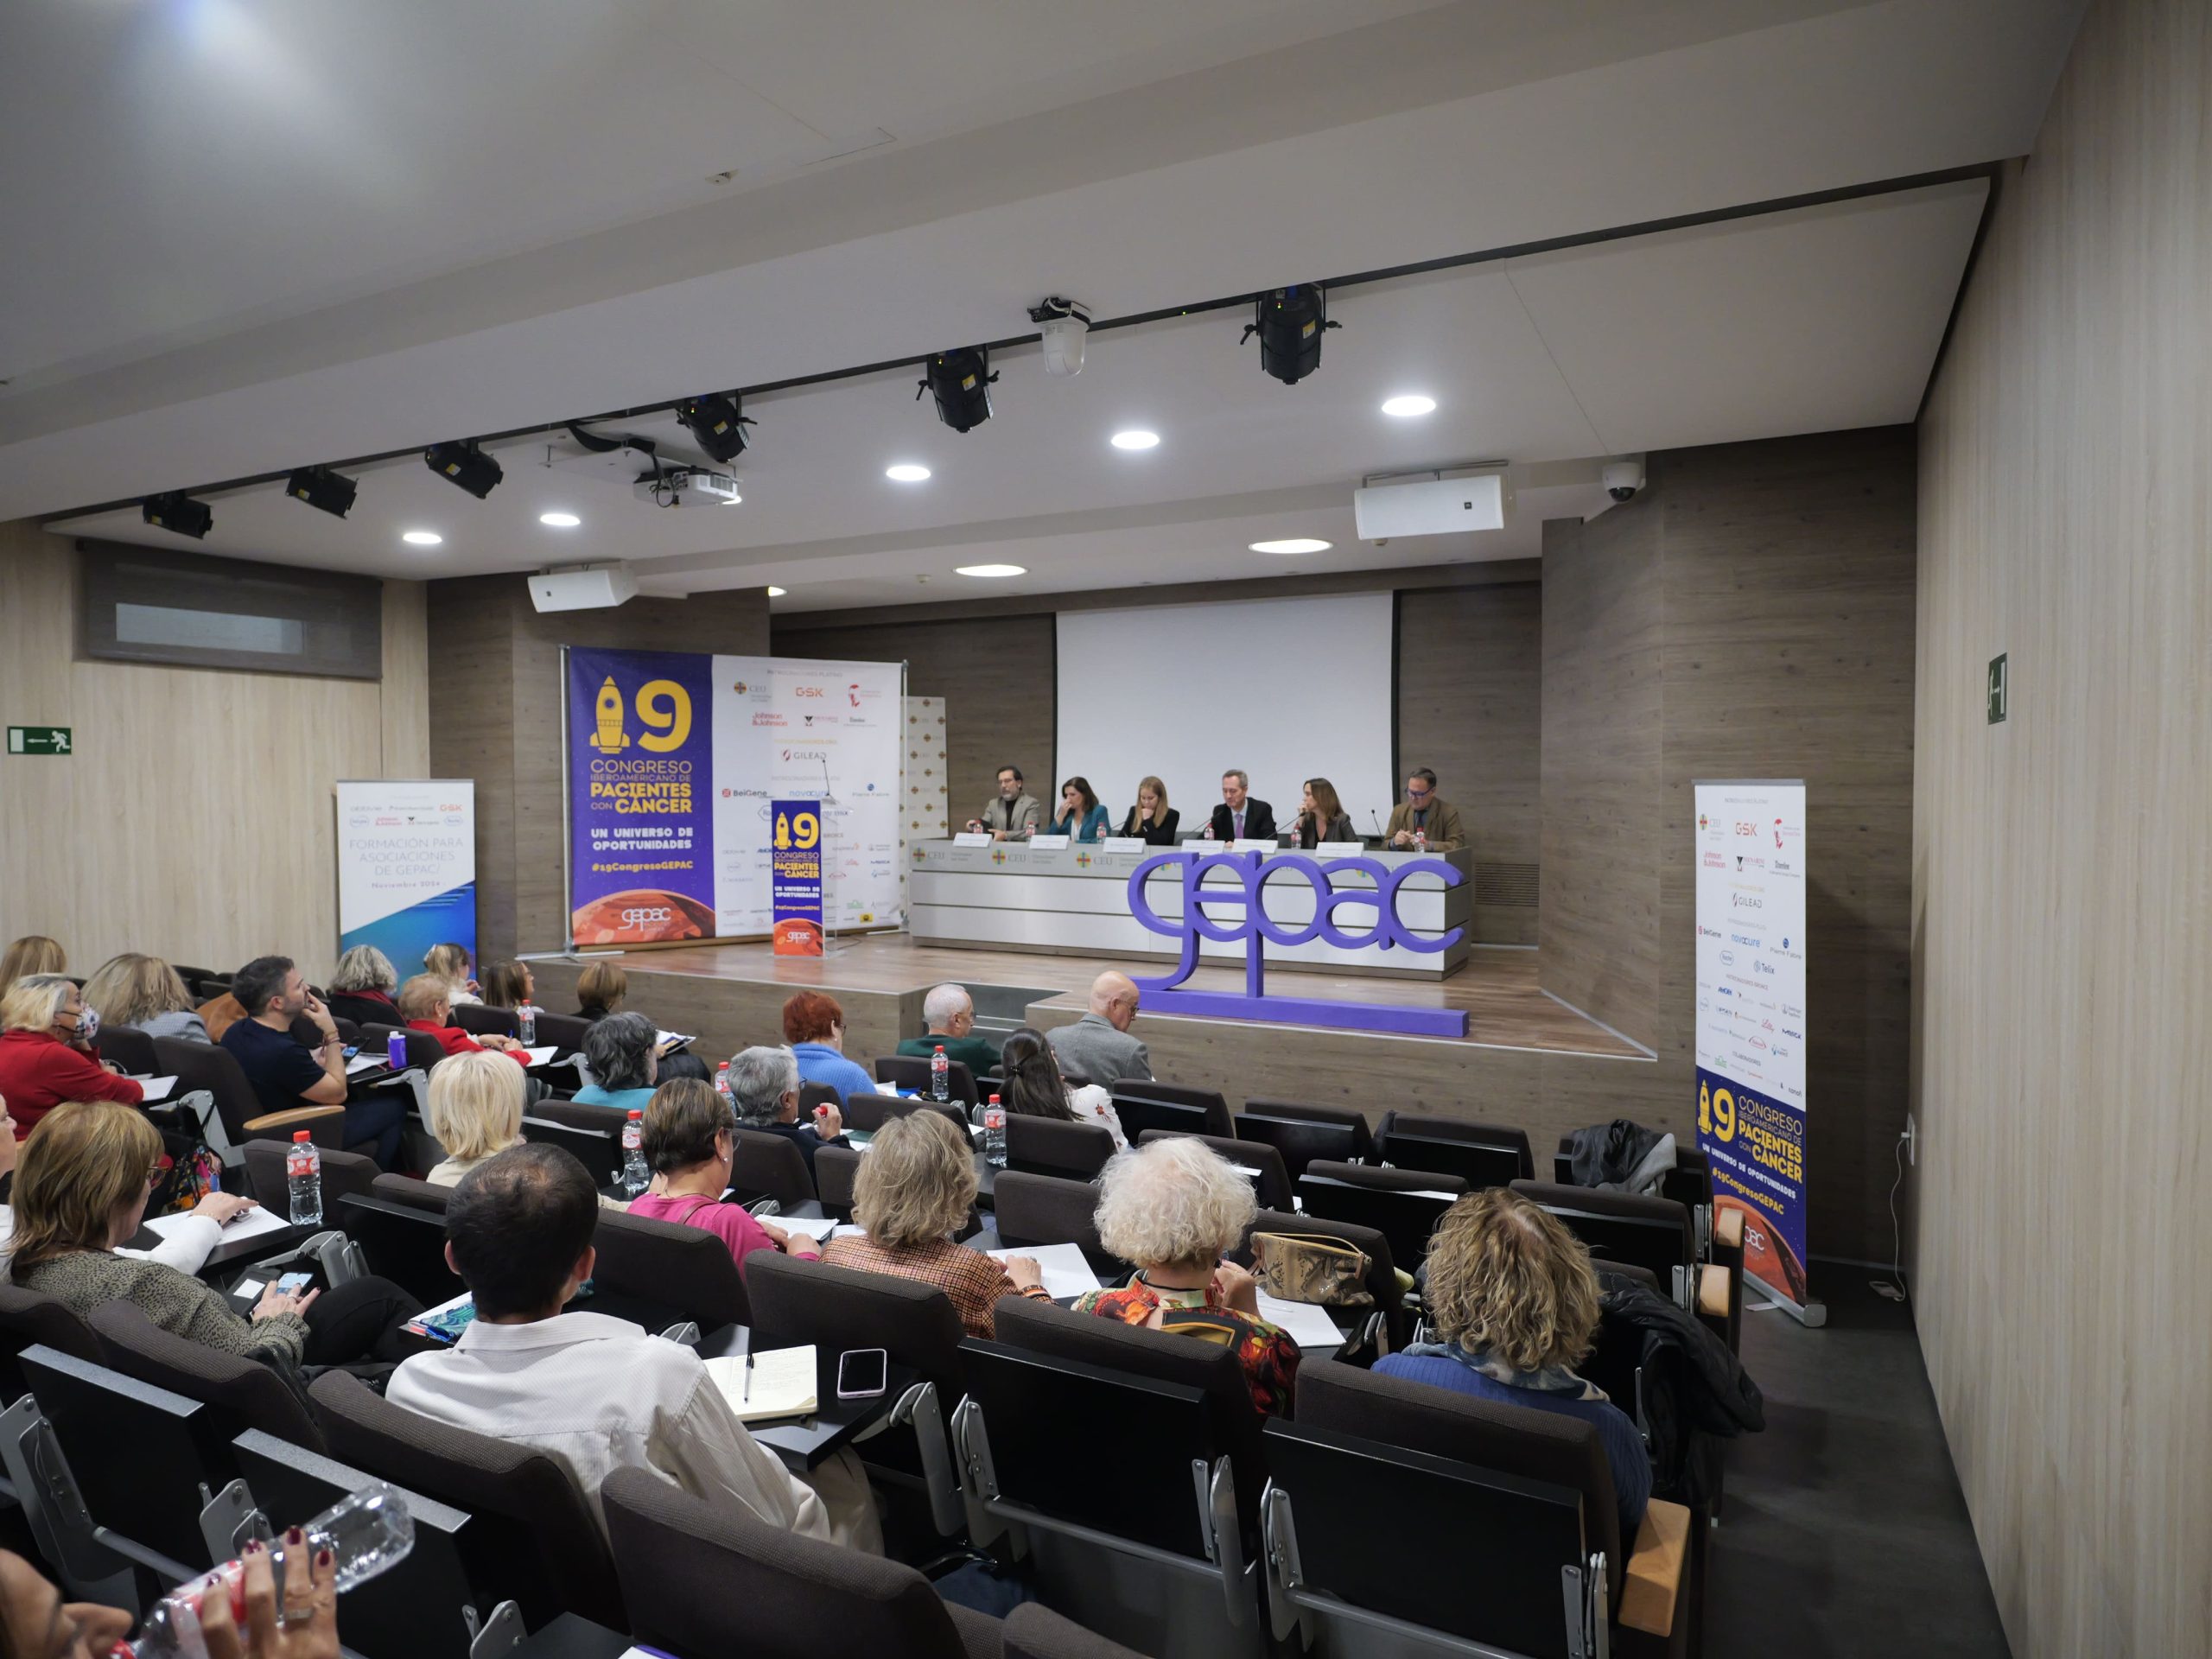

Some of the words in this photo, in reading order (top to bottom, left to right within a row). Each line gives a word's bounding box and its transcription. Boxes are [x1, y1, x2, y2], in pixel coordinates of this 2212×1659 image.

[796, 687, 823, 697] GSK
[793, 751, 827, 760] GILEAD
[591, 760, 692, 774] CONGRESO
[591, 782, 691, 797] PACIENTES
[733, 789, 768, 798] BeiGene
[591, 828, 608, 838] UN
[614, 827, 673, 837] UNIVERSO
[678, 827, 693, 836] DE
[1736, 823, 1757, 836] GSK
[350, 836, 428, 849] FORMACIÓN
[433, 838, 463, 847] PARA
[593, 840, 692, 850] OPORTUNIDADES
[359, 851, 455, 862] ASOCIACIONES
[927, 850, 945, 860] CEU
[1007, 854, 1027, 863] CEU
[1093, 856, 1113, 865] CEU
[375, 866, 391, 875] DE
[592, 861, 693, 872] #19CongresoGEPAC
[774, 862, 819, 871] PACIENTES
[1739, 897, 1762, 908] GILEAD
[618, 907, 671, 931] gepac
[1127, 849, 1465, 999] gepac
[1762, 963, 1774, 975] Telix
[1738, 1096, 1802, 1135] CONGRESO
[1738, 1110, 1792, 1142] IBEROAMERICANO
[1793, 1135, 1802, 1146] DE
[1738, 1120, 1802, 1164] PACIENTES
[1738, 1141, 1751, 1153] CON
[1702, 1143, 1710, 1154] UN
[1712, 1147, 1737, 1166] UNIVERSO
[1738, 1162, 1745, 1173] DE
[1747, 1167, 1796, 1199] OPORTUNIDADES
[1713, 1167, 1784, 1215] #19CongresoGEPAC
